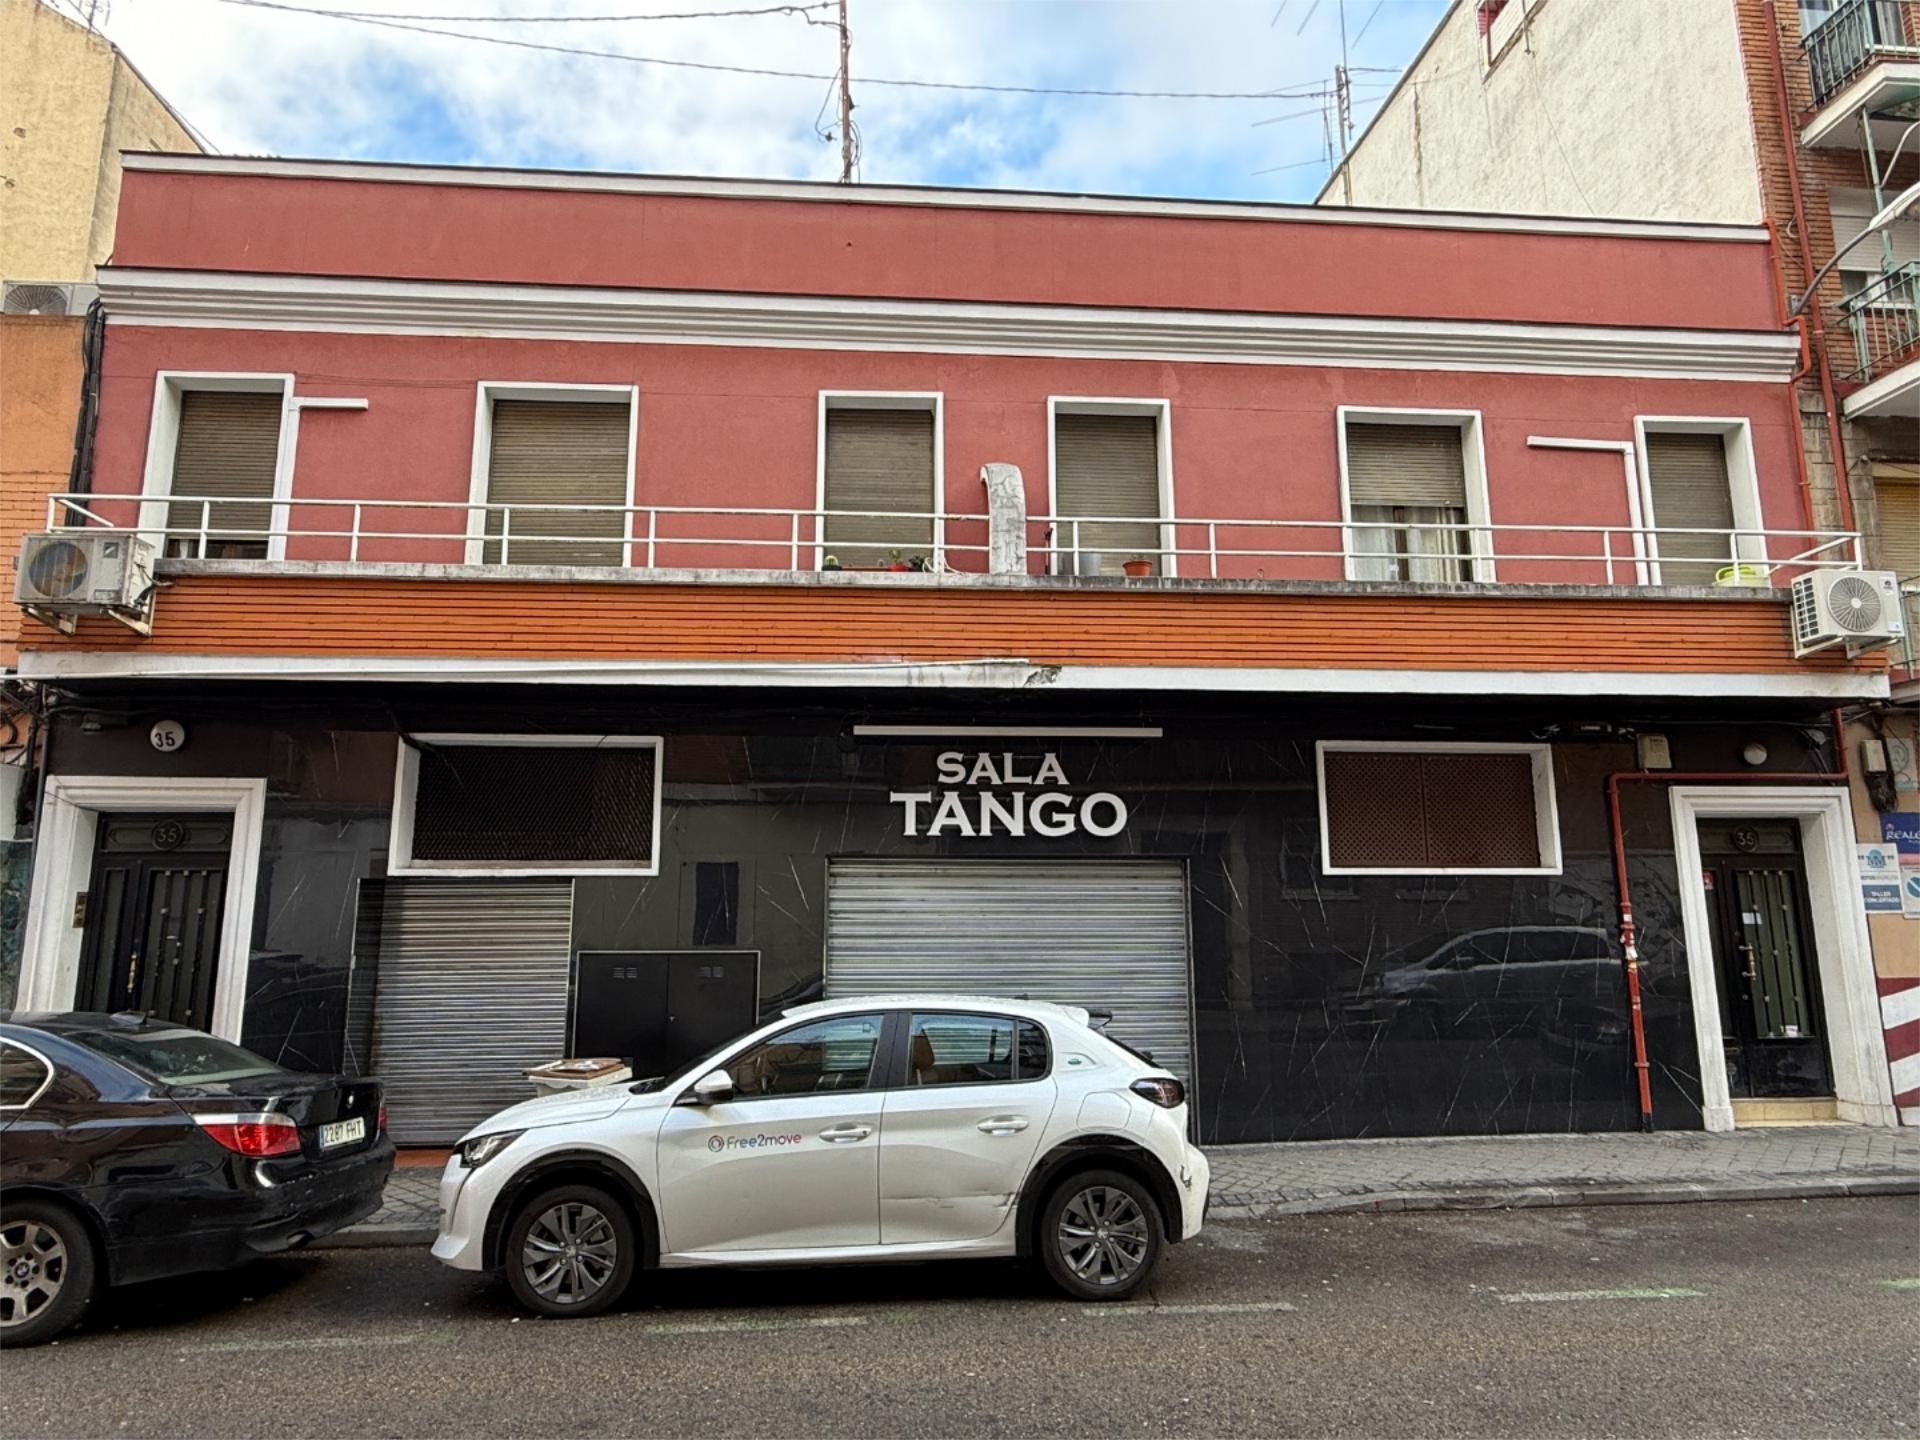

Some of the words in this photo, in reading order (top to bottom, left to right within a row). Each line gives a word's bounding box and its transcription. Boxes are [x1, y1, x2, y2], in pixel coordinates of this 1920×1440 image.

[155, 731, 176, 748] 35
[937, 751, 1070, 785] SALA
[889, 791, 1128, 838] TANGO
[157, 827, 177, 842] 35
[1736, 832, 1754, 846] 35
[346, 1120, 361, 1138] FHT
[727, 1133, 802, 1149] Free2move
